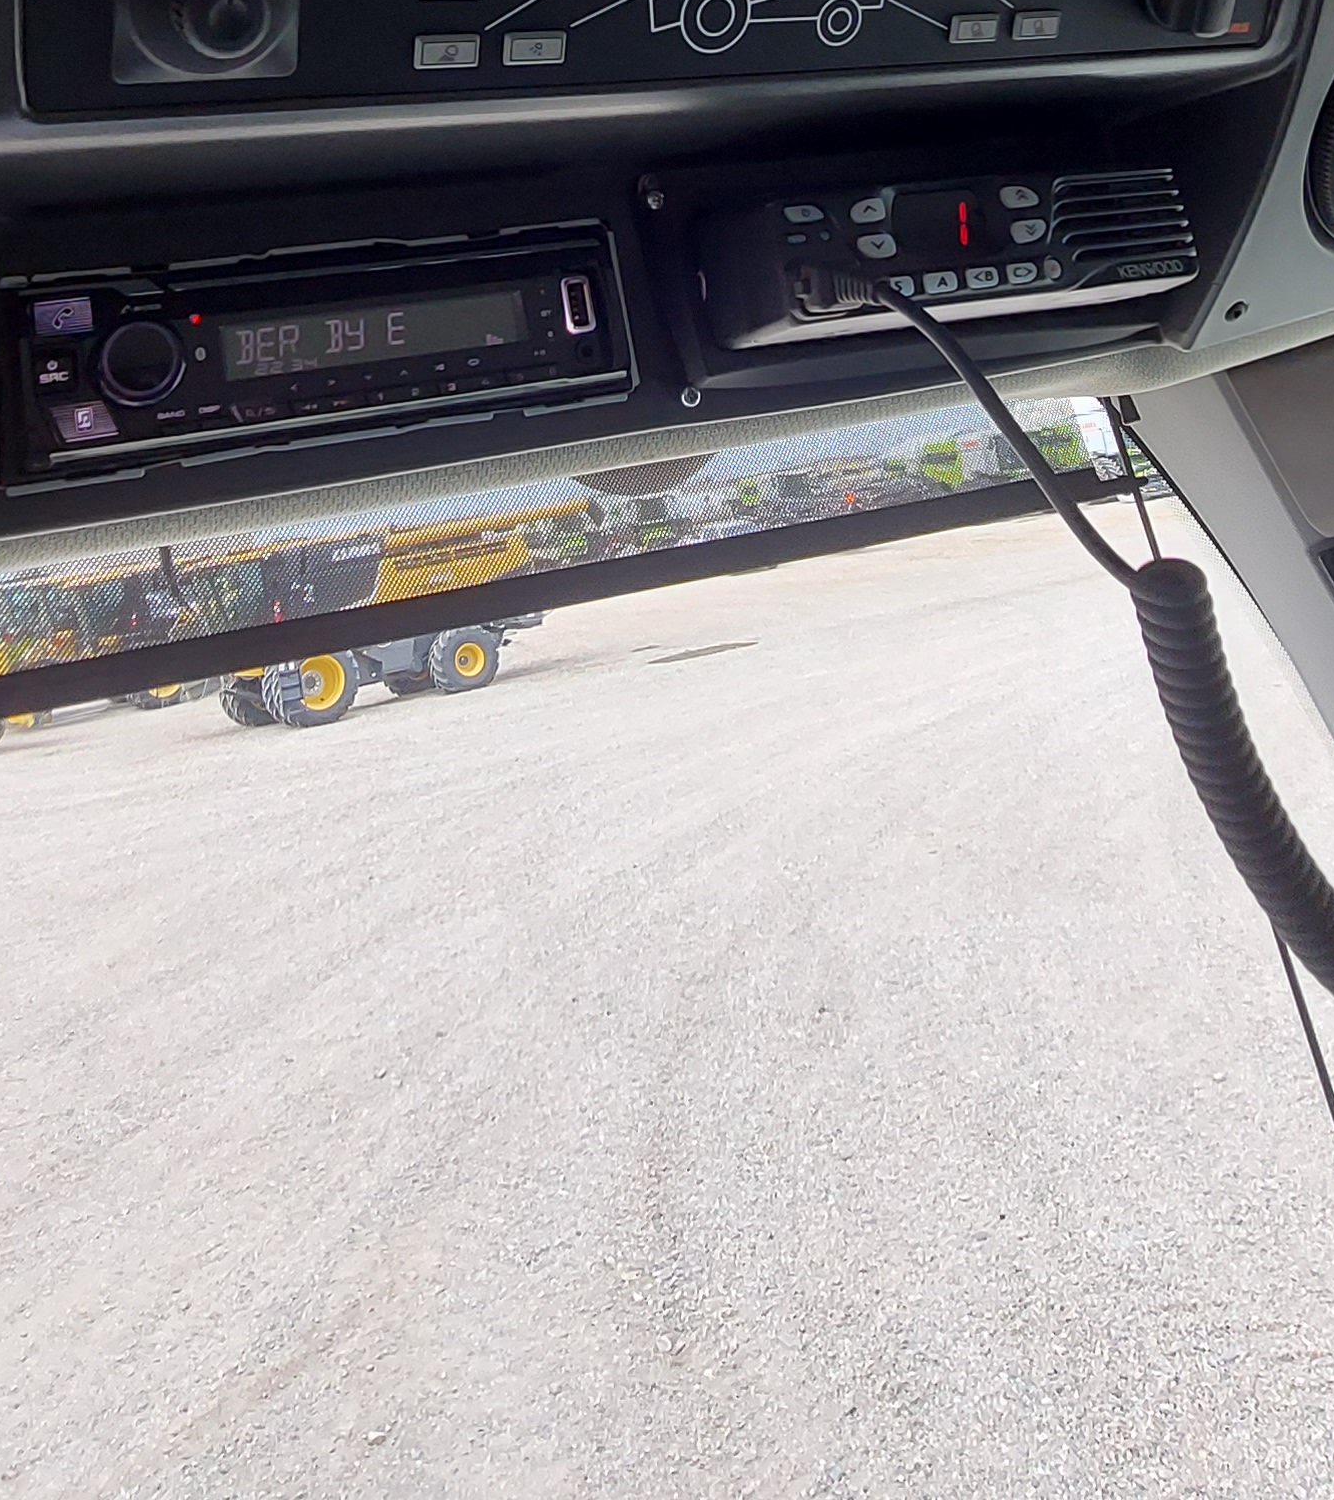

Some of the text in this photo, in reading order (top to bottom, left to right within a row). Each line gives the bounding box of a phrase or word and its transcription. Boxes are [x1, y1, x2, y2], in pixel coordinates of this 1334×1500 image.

[1117, 260, 1184, 279] KENWOOD
[937, 276, 949, 288] A
[386, 311, 406, 346] E
[39, 370, 70, 385] SRC
[447, 382, 457, 392] 3
